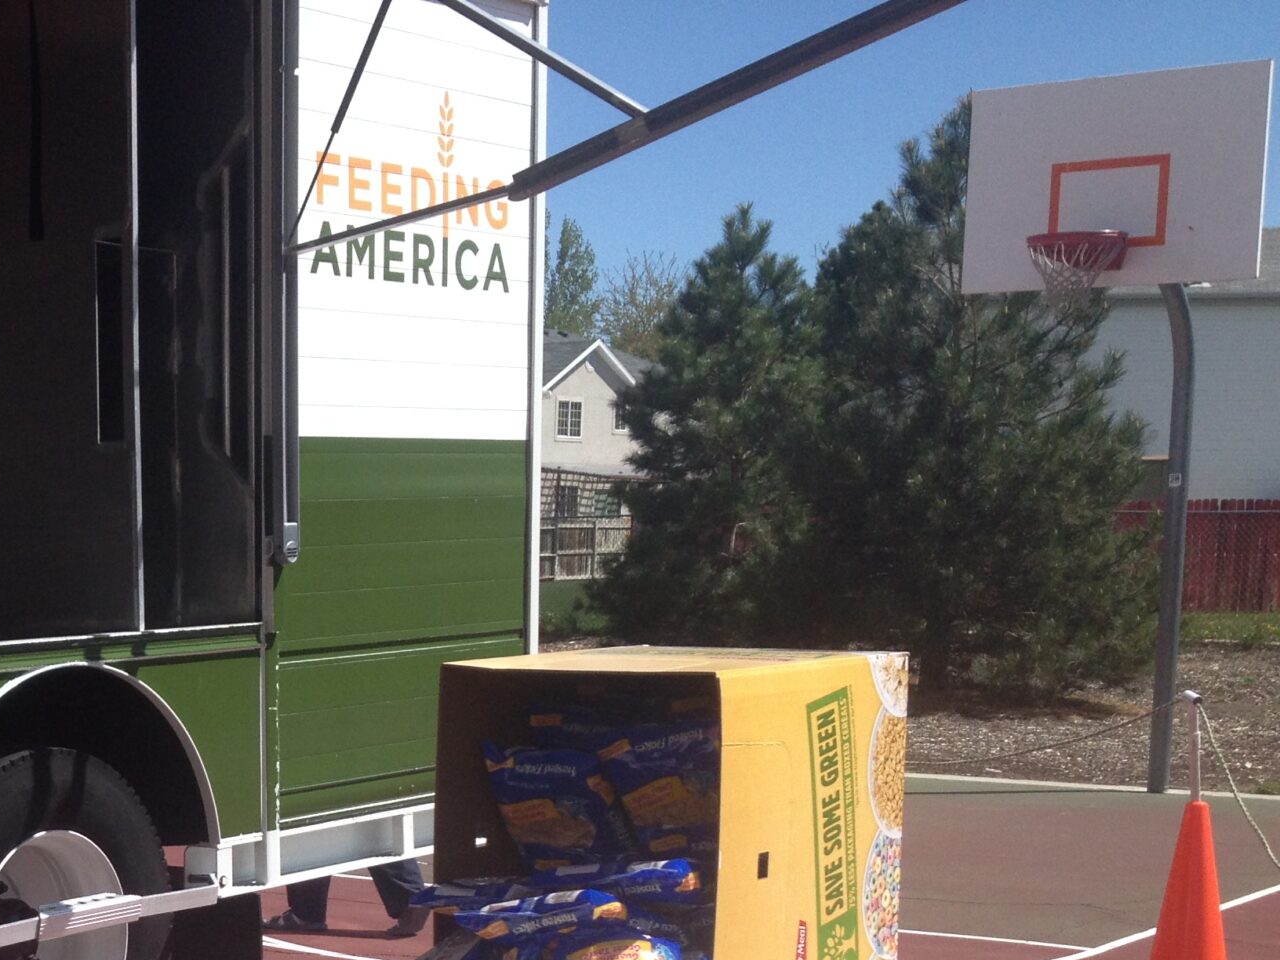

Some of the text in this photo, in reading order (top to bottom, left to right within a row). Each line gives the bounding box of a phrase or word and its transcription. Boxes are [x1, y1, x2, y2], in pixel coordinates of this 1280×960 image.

[315, 150, 509, 238] FEEDING
[310, 220, 510, 293] AMERICA
[816, 708, 844, 916] SAVE SOME GREEN
